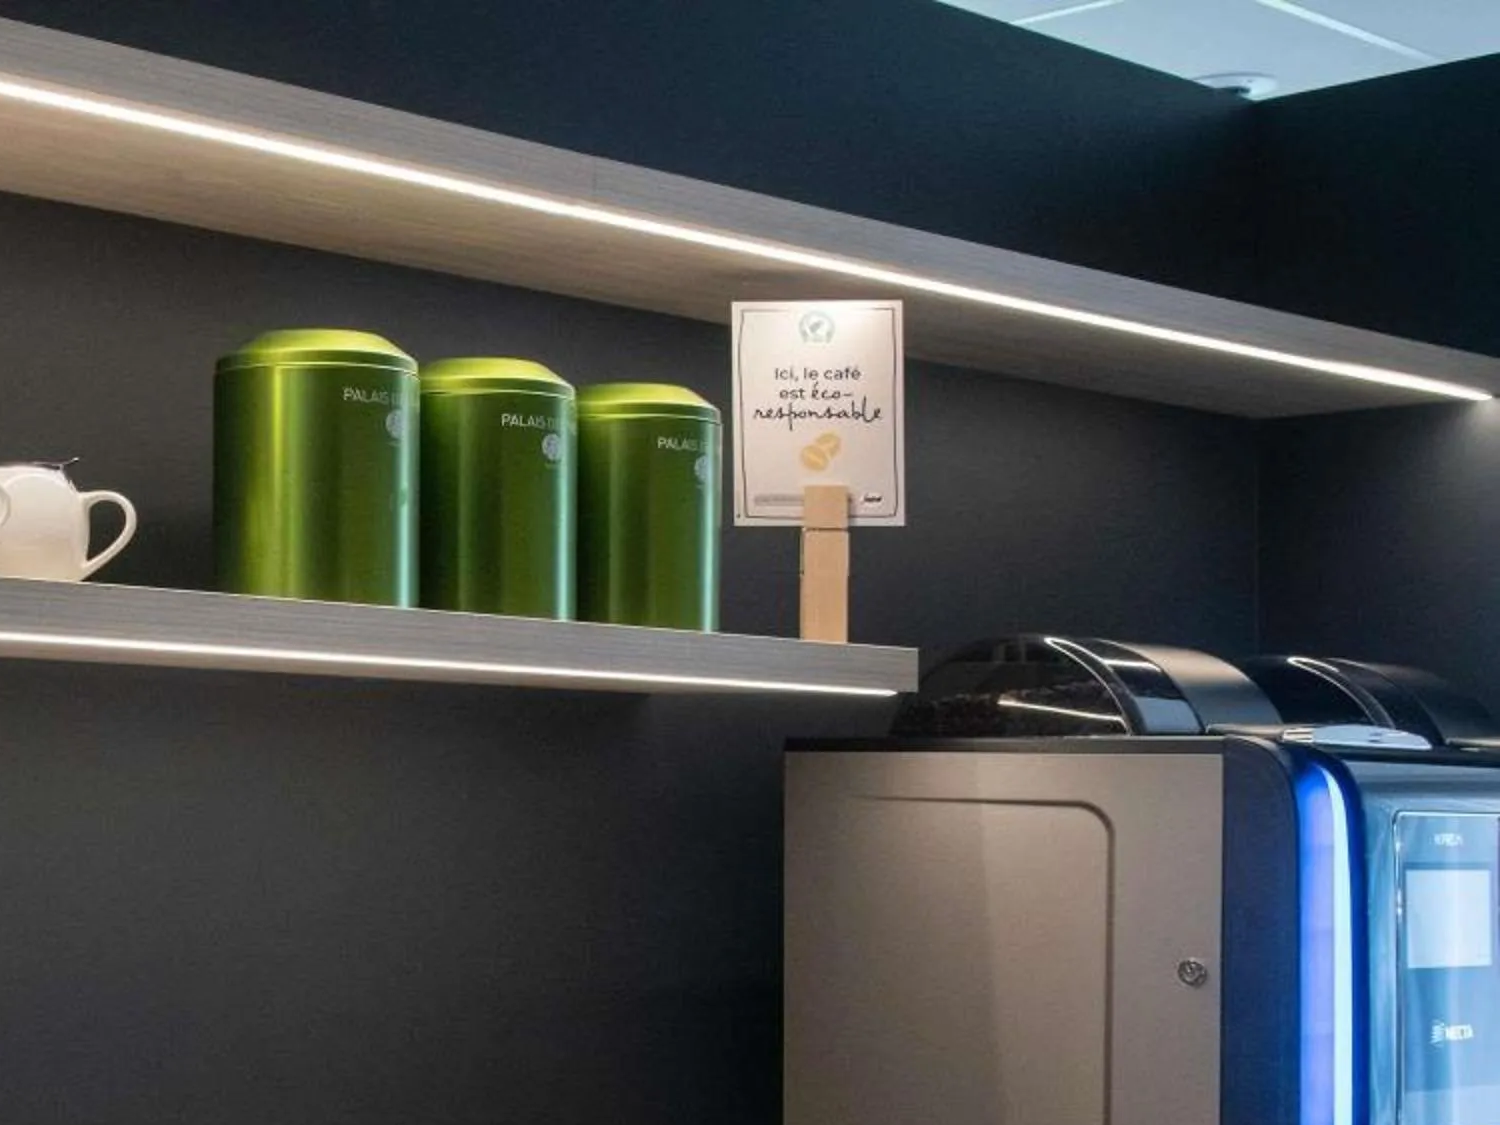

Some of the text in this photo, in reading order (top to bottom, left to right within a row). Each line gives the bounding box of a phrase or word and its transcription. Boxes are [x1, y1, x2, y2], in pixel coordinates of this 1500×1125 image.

[774, 365, 861, 382] Ici, le café
[779, 387, 805, 400] est
[501, 413, 546, 430] PALAIS
[753, 395, 882, 431] responsable
